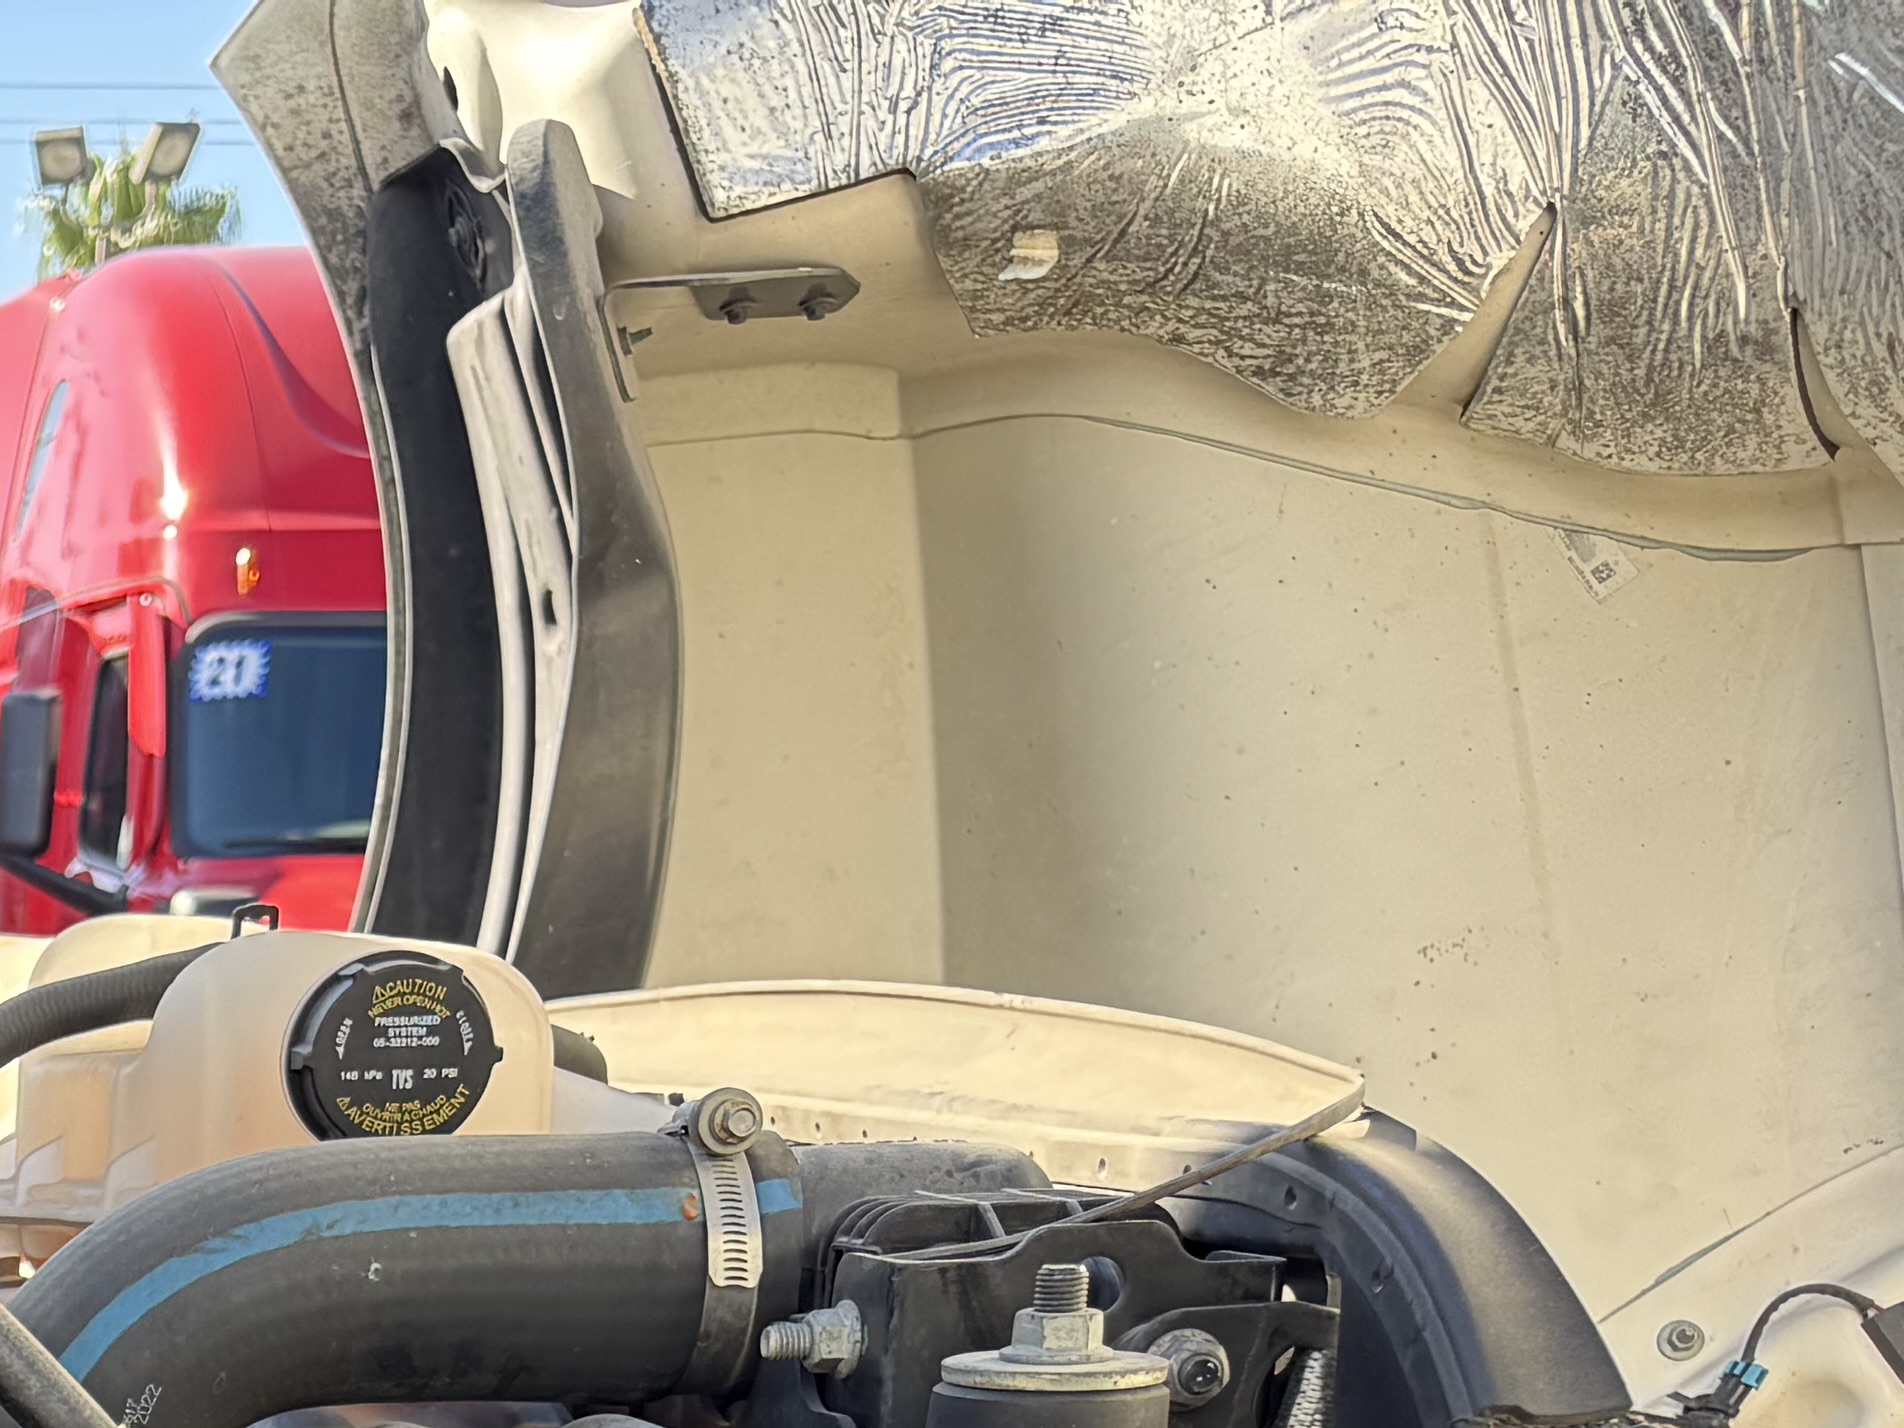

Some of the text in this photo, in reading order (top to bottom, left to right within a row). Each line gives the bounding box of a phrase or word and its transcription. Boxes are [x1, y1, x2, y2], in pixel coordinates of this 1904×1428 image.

[386, 979, 447, 1000] CAUTION
[388, 1027, 426, 1036] SYSTEM
[392, 1069, 413, 1090] TVS
[423, 1068, 458, 1078] 20 PSI
